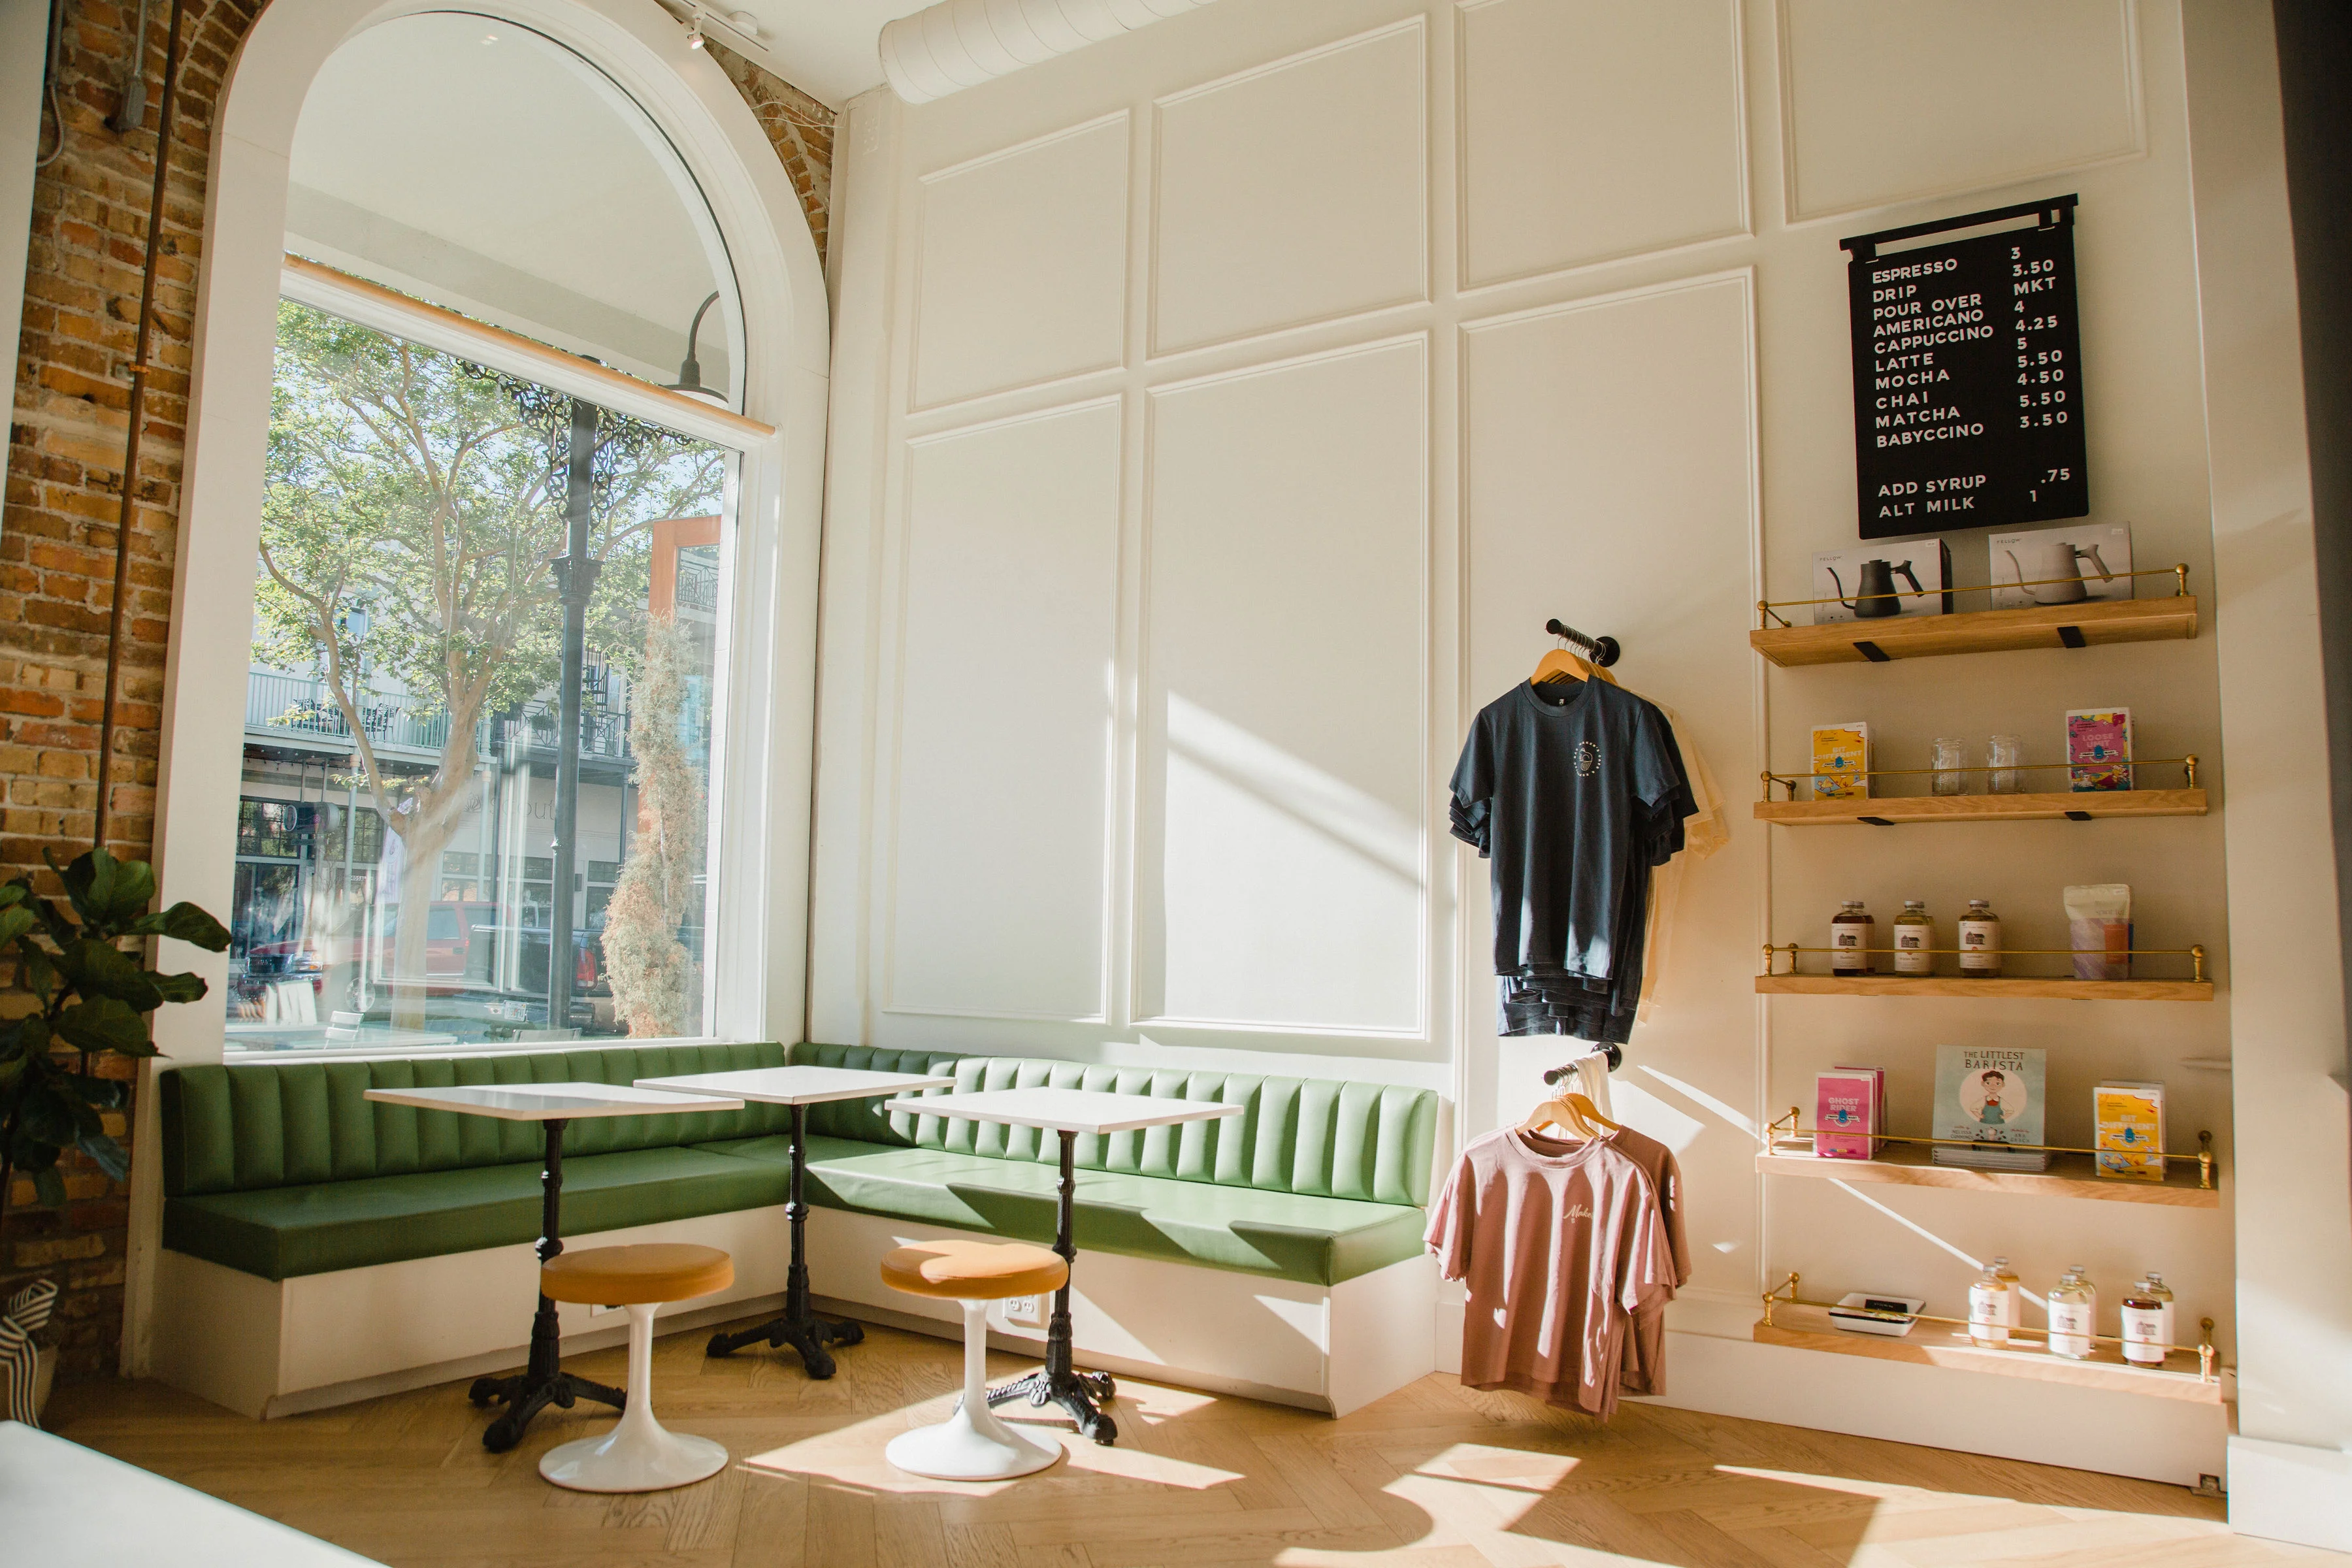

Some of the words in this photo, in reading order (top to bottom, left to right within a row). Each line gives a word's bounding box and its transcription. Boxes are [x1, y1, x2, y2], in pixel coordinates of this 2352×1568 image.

[1872, 259, 1957, 284] ESPRESSO
[2011, 247, 2021, 259] 3
[1872, 284, 1917, 302] DRIP
[2012, 259, 2053, 277] 3.50
[1873, 301, 1922, 321] POUR
[1931, 293, 1982, 312] OVER
[2014, 277, 2056, 296] MKT
[1873, 309, 1984, 338] AMERICANO
[2014, 301, 2025, 313] 4
[1874, 325, 1993, 354] CAPPUCCINO
[2015, 315, 2057, 332] 4.25
[1875, 352, 1933, 372] LATTE
[2017, 337, 2027, 350] 5
[1875, 369, 1950, 390] MOCHA
[2017, 350, 2063, 368] 5.50
[1876, 391, 1928, 410] CHAI
[2017, 369, 2064, 385] 4.50
[1875, 406, 1961, 429] MATCHA
[2019, 390, 2066, 408] 5.50
[1876, 423, 1984, 448] BABYCCINO
[2019, 411, 2068, 429] 3.50
[1878, 482, 1918, 497] ADD
[1925, 474, 1986, 493] SYRUP
[2041, 468, 2070, 483] .75
[1879, 502, 1915, 518] ALT
[1927, 497, 1974, 513] MILK
[2029, 490, 2036, 502] 1
[1816, 750, 1863, 760] DIFFERENT
[1965, 1059, 2023, 1071] BARISTA
[1980, 1051, 2025, 1060] LITTLEST
[1828, 1097, 1860, 1105] GHOST
[2100, 1121, 2156, 1130] DIFFERENT
